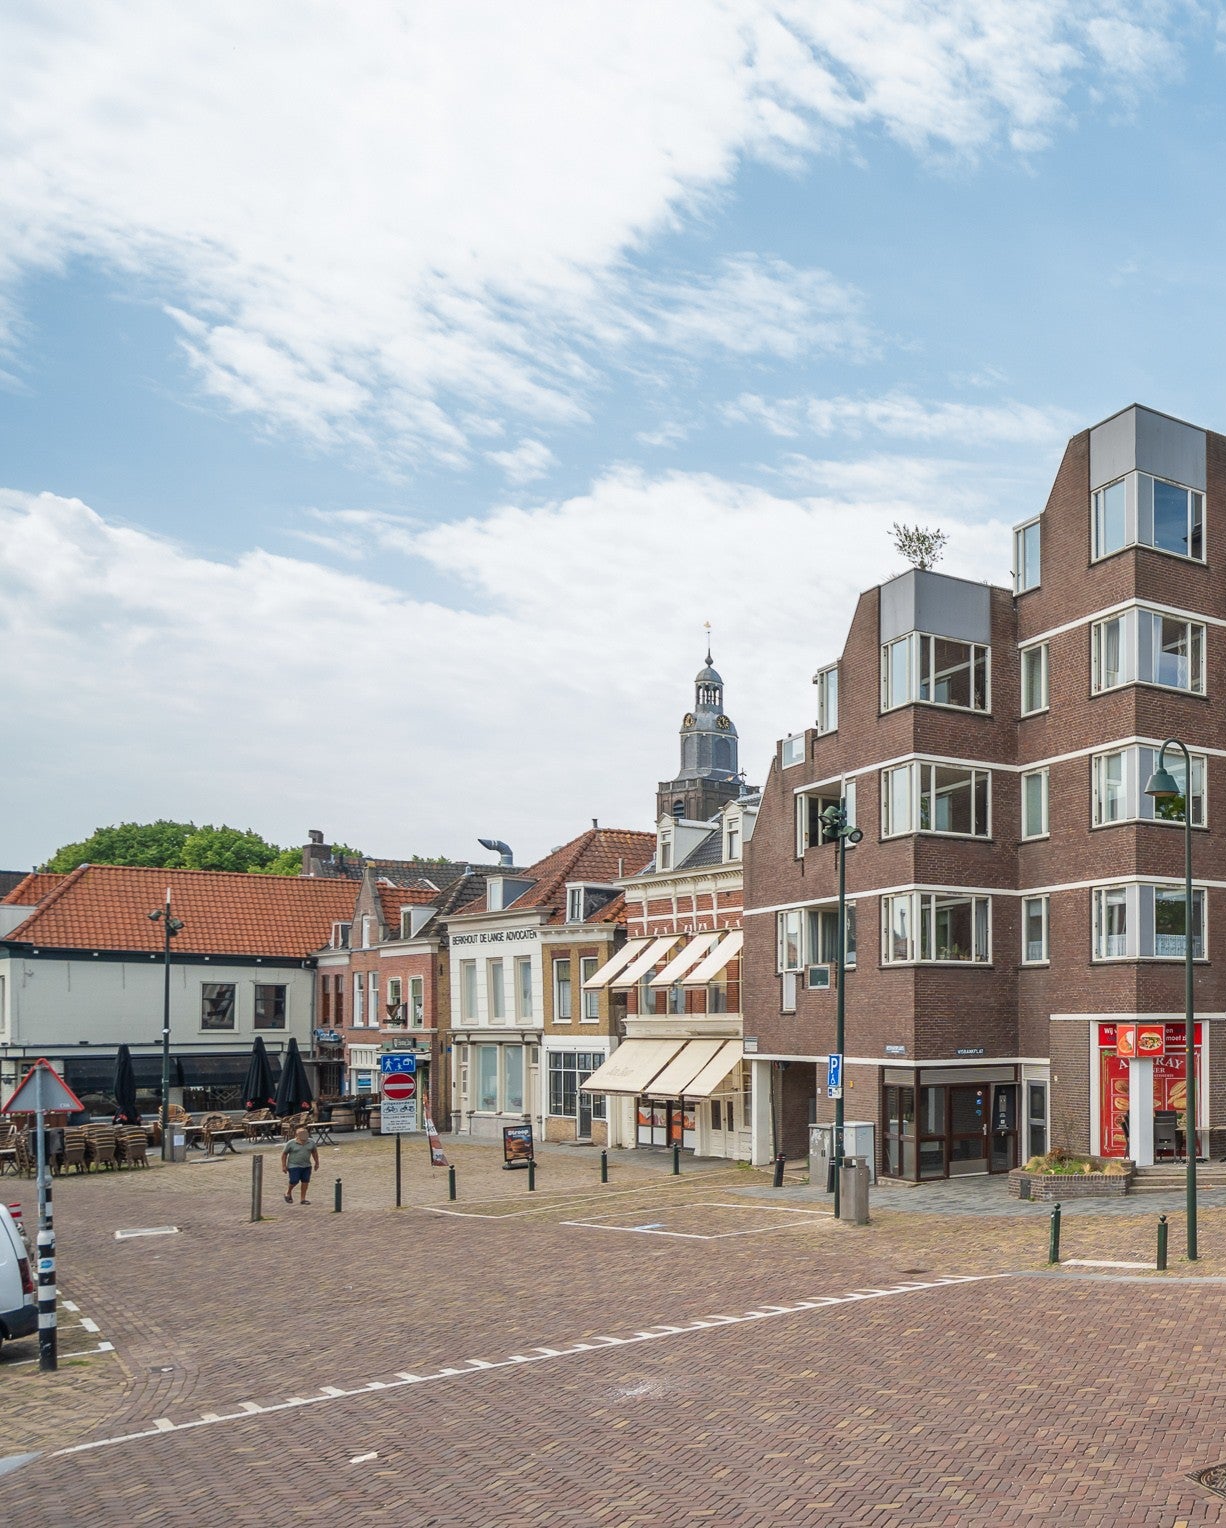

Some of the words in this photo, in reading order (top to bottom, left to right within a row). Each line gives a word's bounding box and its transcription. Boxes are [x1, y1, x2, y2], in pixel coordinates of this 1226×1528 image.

[452, 934, 478, 945] BERKHOUT
[506, 929, 537, 941] ADVOCATEN
[830, 1057, 838, 1074] P
